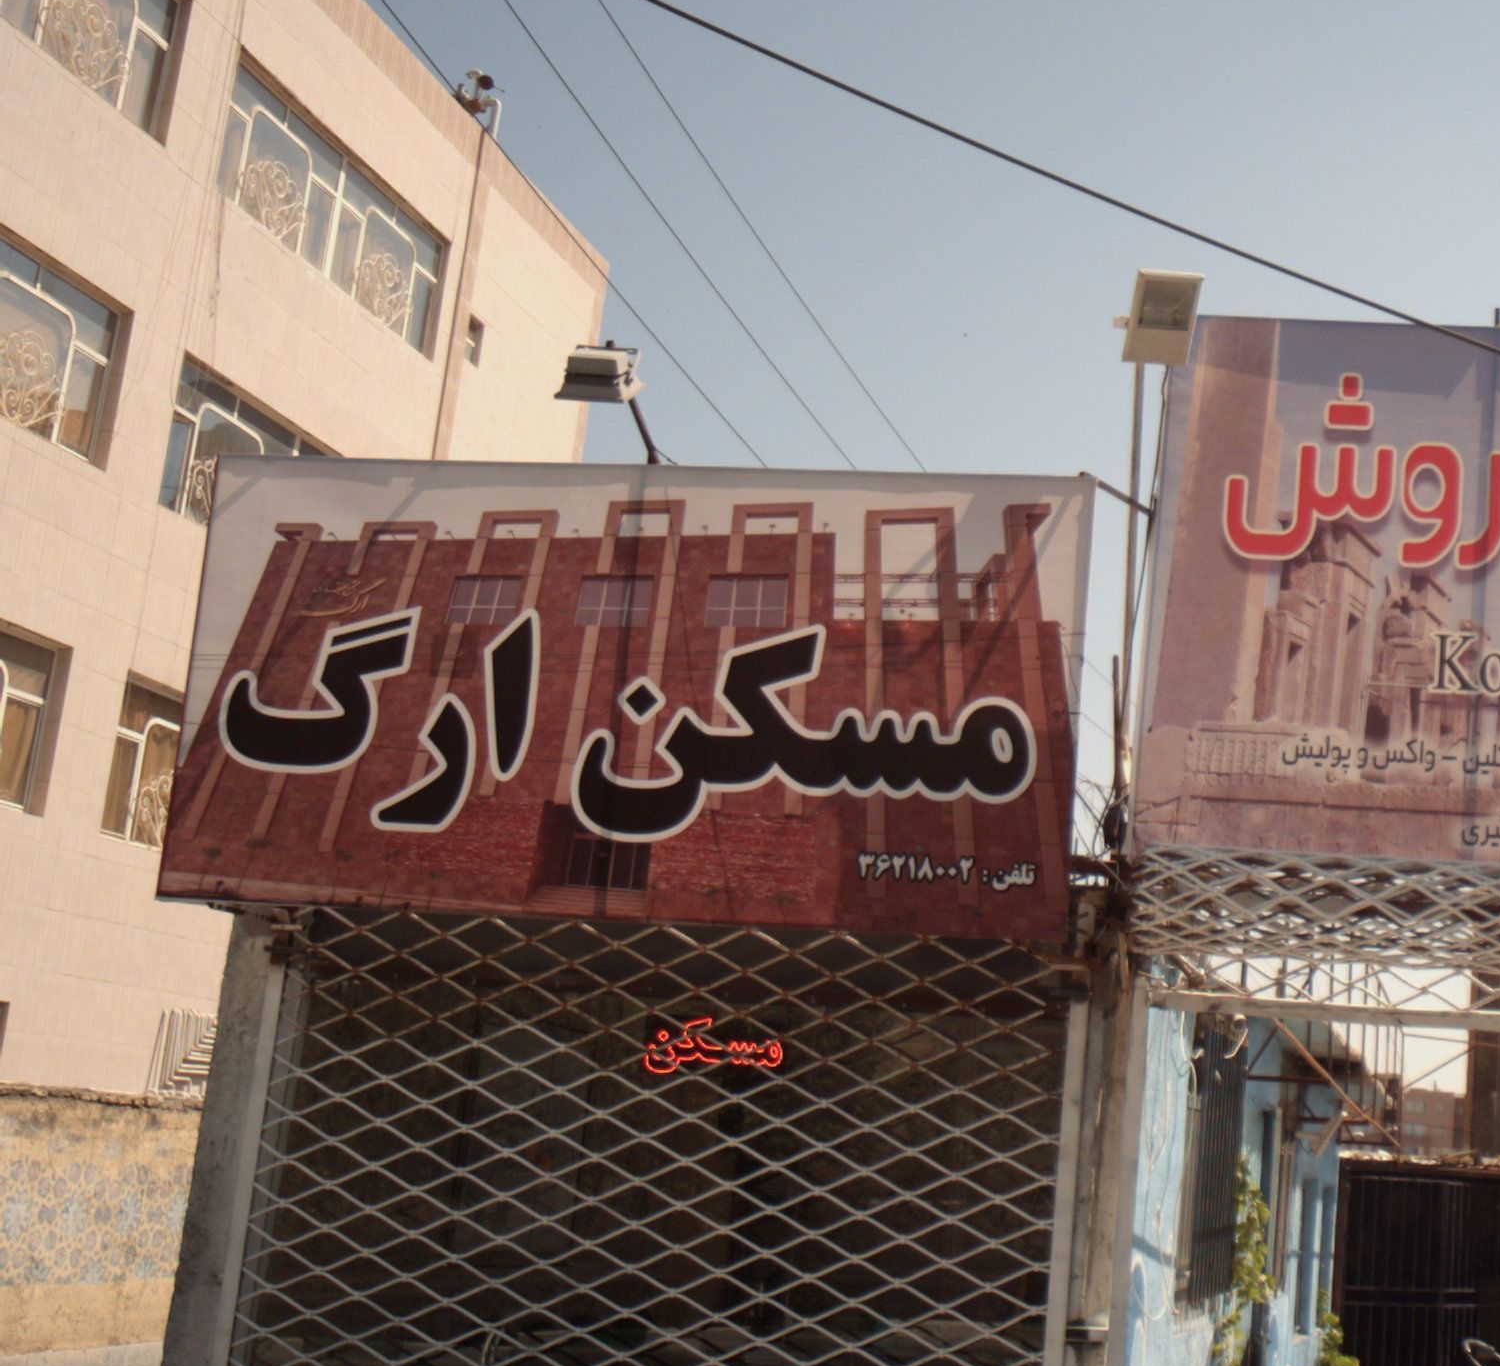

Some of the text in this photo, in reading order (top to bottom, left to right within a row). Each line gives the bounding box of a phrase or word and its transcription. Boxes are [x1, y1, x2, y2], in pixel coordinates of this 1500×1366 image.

[219, 606, 1038, 842] مسکن ارگ
[1282, 732, 1351, 774] پولیش
[1357, 746, 1369, 769] و
[1372, 738, 1436, 772] واکس
[857, 853, 974, 883] ۳۶۲۱۸۰۰۲
[644, 1017, 783, 1075] مسکن
